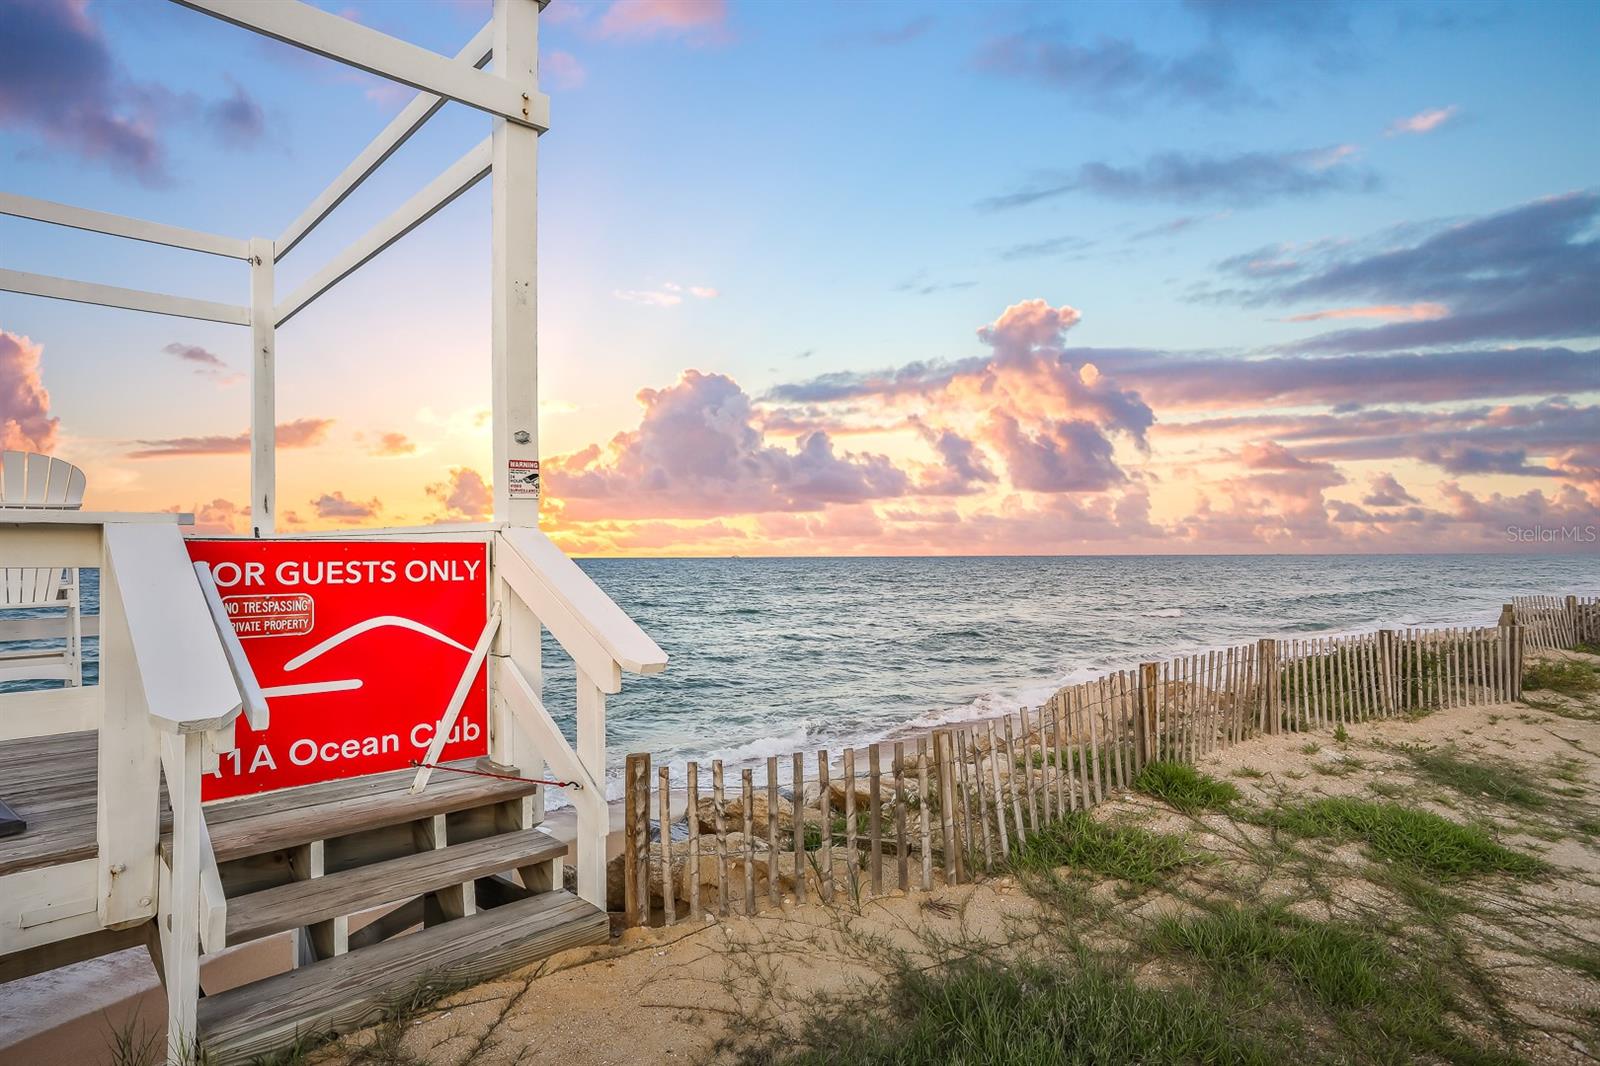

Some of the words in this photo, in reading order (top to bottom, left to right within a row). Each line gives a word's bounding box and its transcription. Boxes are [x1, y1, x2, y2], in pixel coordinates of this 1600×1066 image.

[210, 561, 265, 587] OR
[275, 560, 396, 585] GUESTS
[405, 560, 480, 582] ONLY
[224, 602, 239, 614] NO
[243, 600, 308, 613] TRESPASSING
[231, 621, 261, 632] IVATE
[264, 619, 309, 630] PROPERTY
[289, 738, 399, 766] Ocean
